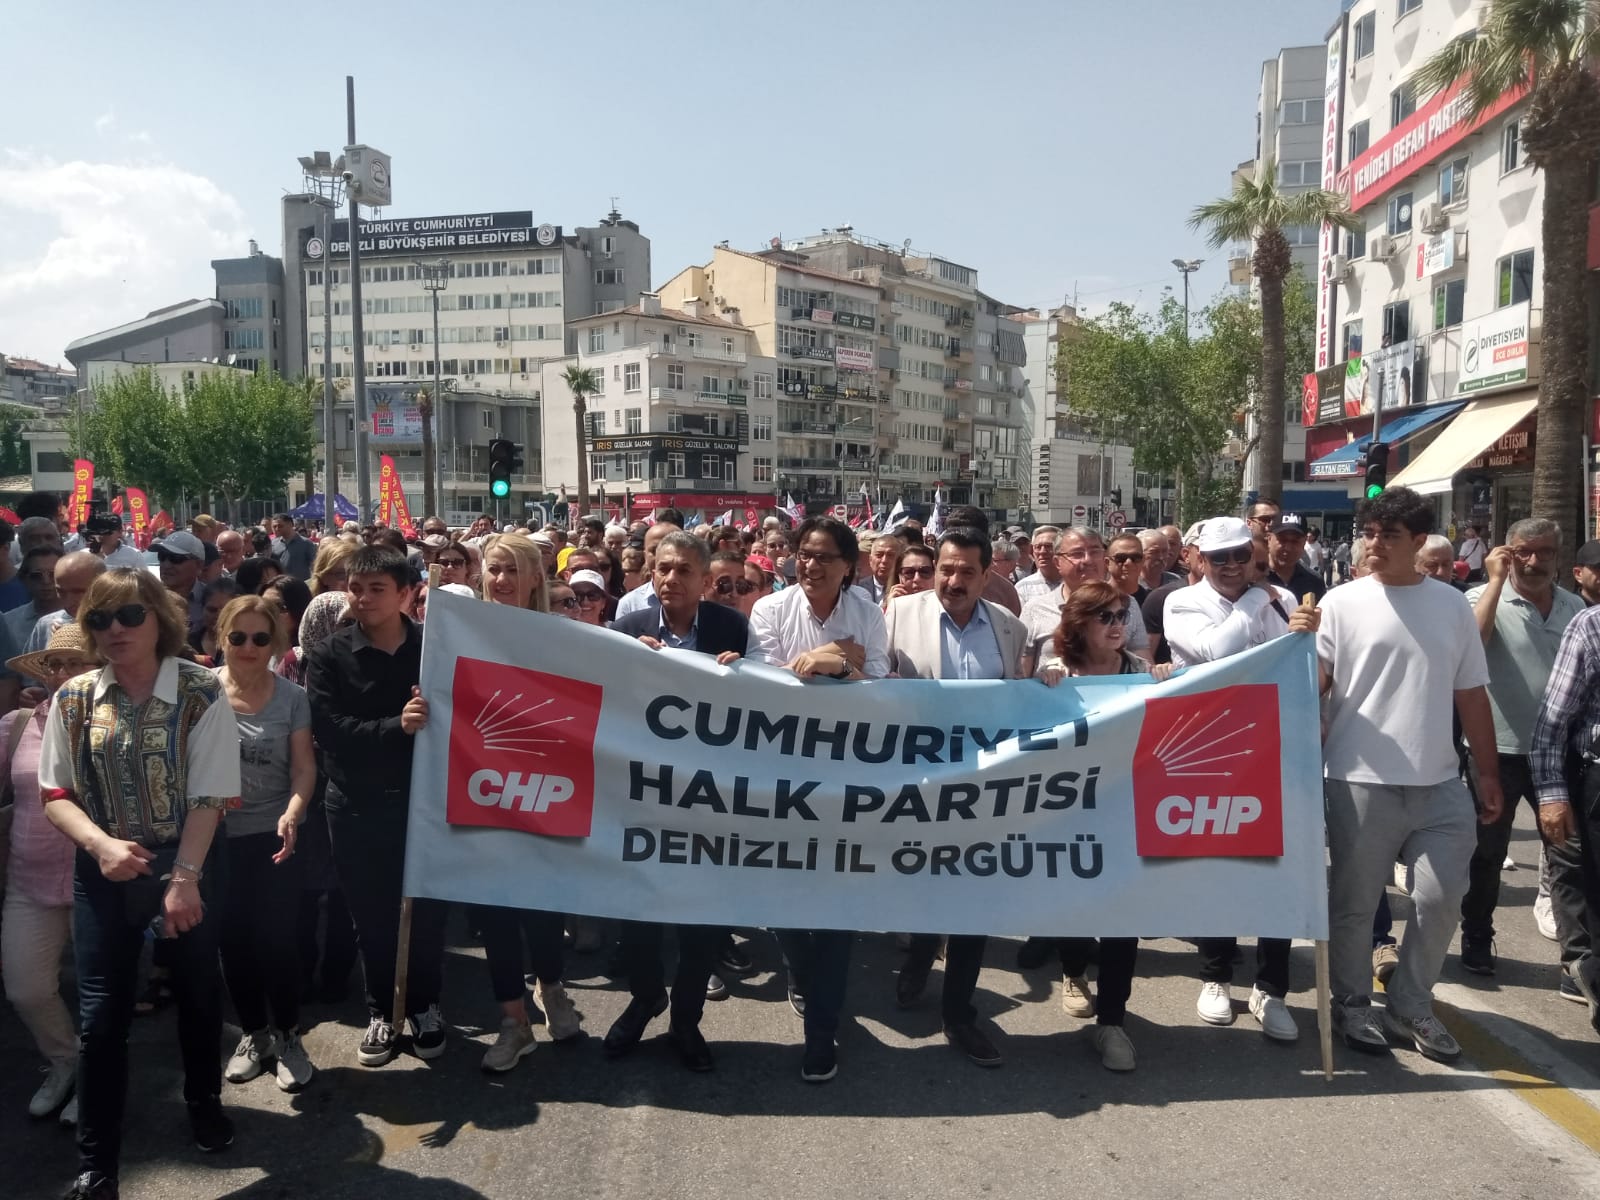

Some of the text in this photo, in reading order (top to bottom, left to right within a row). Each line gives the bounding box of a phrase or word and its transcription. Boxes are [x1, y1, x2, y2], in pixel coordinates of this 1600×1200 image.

[1354, 92, 1473, 195] YENİDEN REFAH PARTİ
[331, 229, 530, 253] DENZLİ BÜYÜKŞEHİR BELEDİYESİ
[359, 214, 494, 235] TÜRKİYE CUMHURİYETİ
[1318, 96, 1337, 368] KARADNİZLİLER
[1038, 444, 1050, 505] CASBRAND
[467, 768, 575, 813] CHP
[629, 760, 1101, 823] HALK PARTİSİ
[1155, 795, 1262, 836] CHP
[622, 827, 1104, 879] DENİZLİ İL ÖRGÜTÜ
